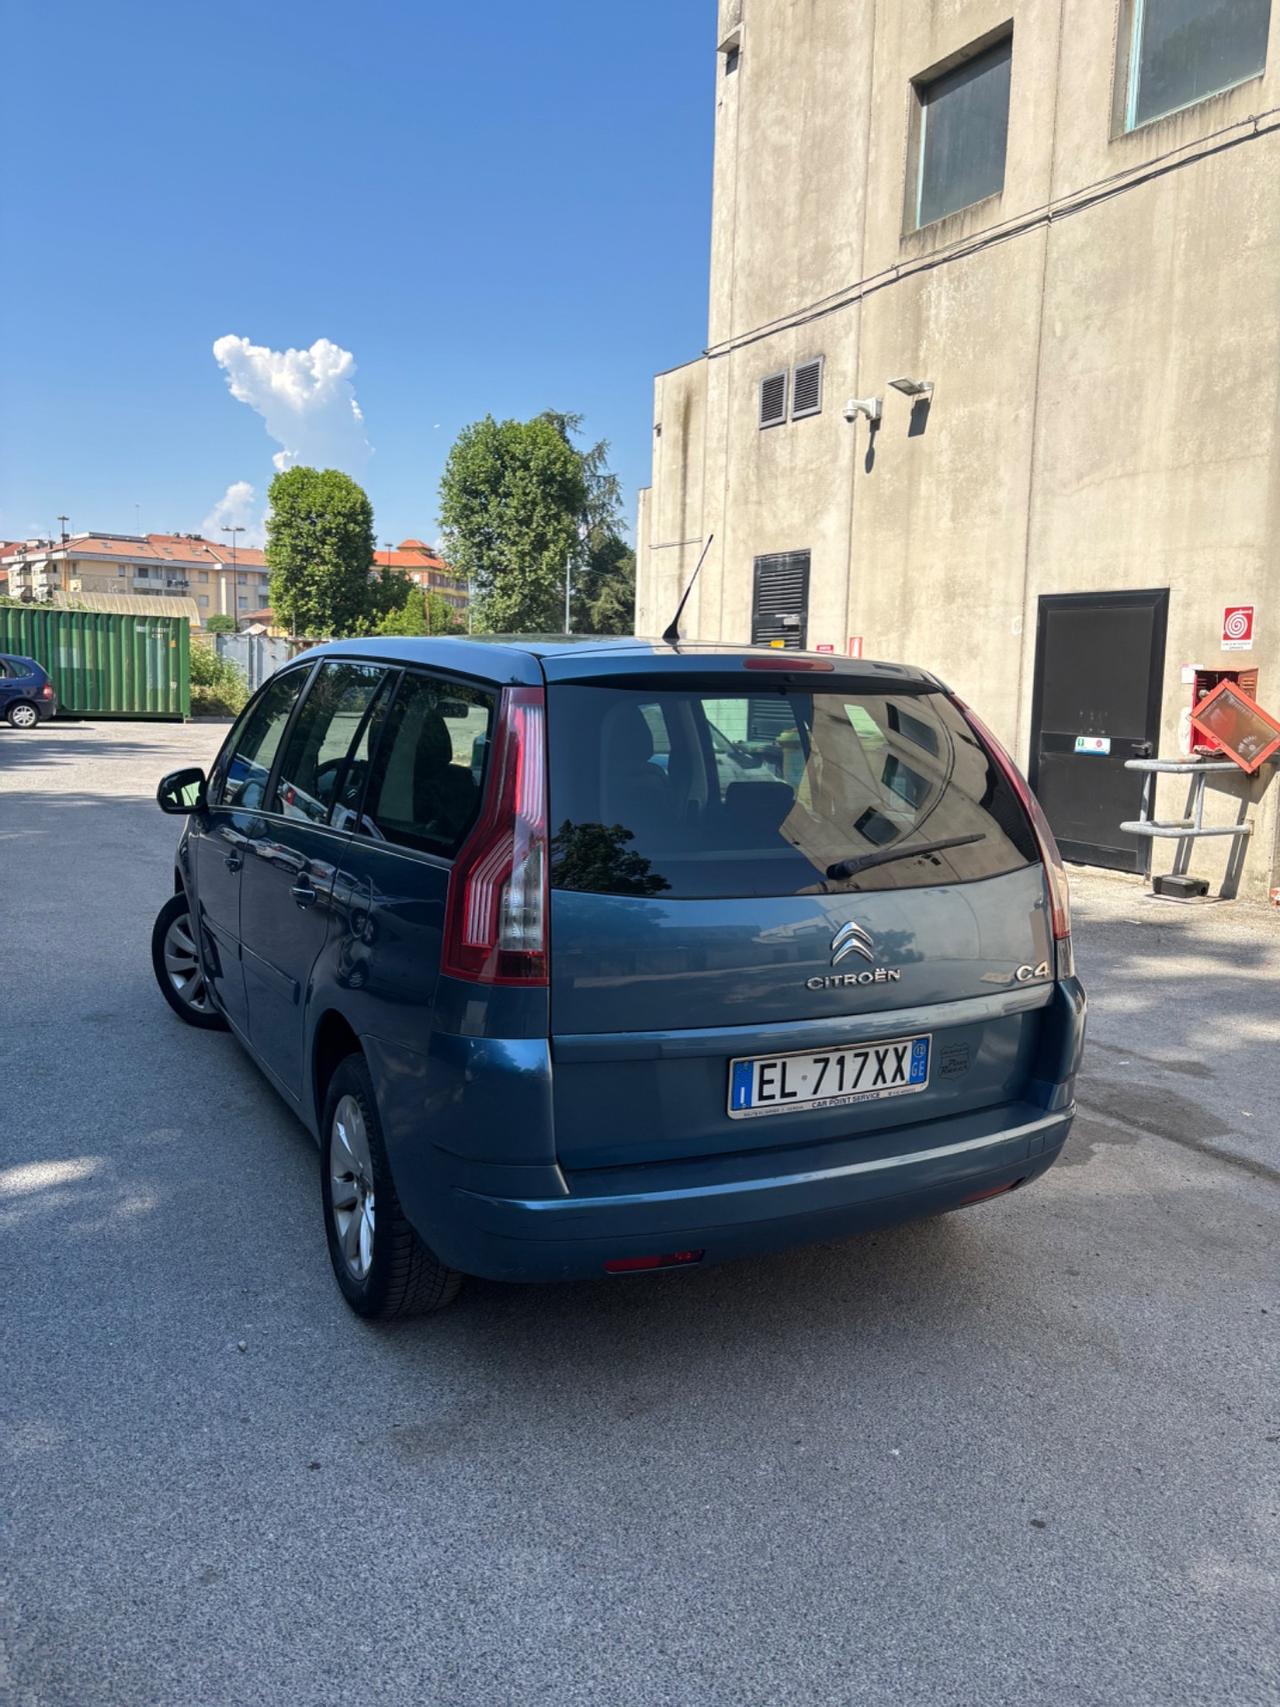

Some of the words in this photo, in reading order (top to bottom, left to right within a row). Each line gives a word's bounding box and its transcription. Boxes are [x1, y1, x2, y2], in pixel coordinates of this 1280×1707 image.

[805, 967, 902, 991] CITROËN
[1015, 960, 1051, 982] C4
[757, 1062, 798, 1102] EL
[812, 1045, 909, 1096] 717XX
[911, 1061, 925, 1077] GE
[811, 1099, 828, 1109] CAR
[828, 1096, 851, 1106] POINT
[851, 1091, 881, 1103] SERVICE
